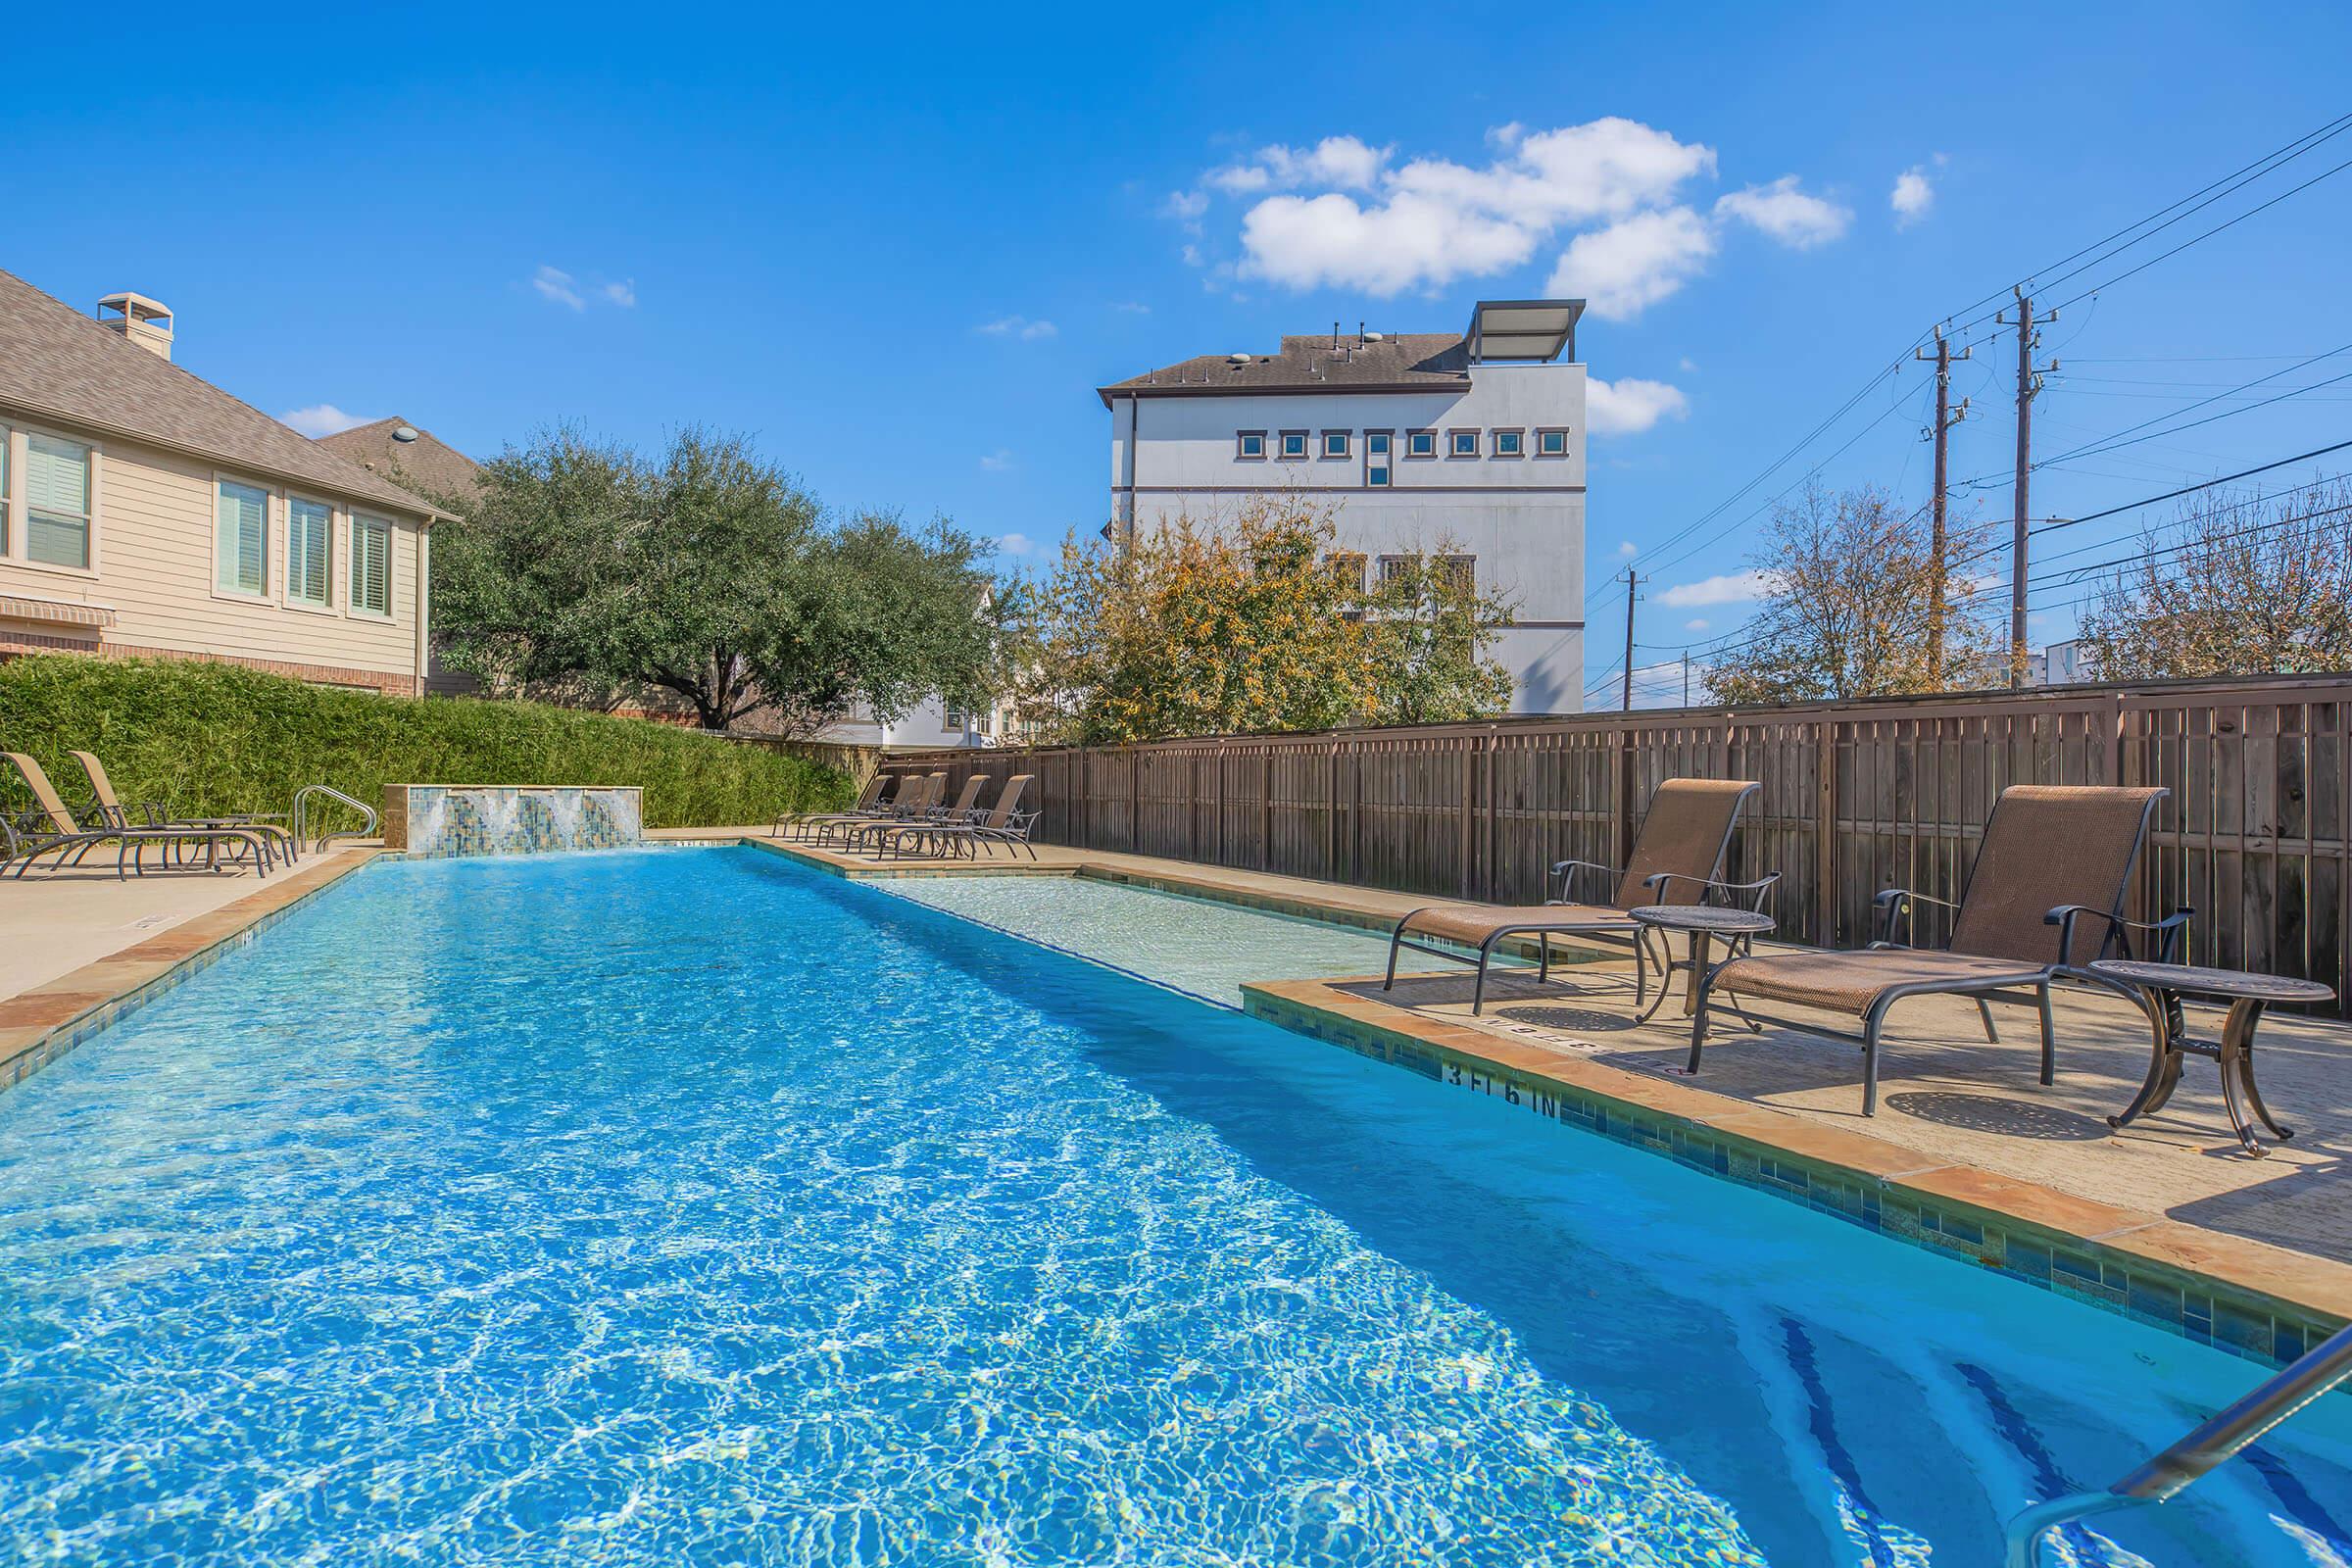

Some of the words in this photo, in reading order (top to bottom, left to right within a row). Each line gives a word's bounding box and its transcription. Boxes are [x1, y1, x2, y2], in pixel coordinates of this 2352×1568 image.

[1448, 1061, 1461, 1086] 3
[1504, 1079, 1521, 1106] 6
[1532, 1086, 1555, 1118] IN
